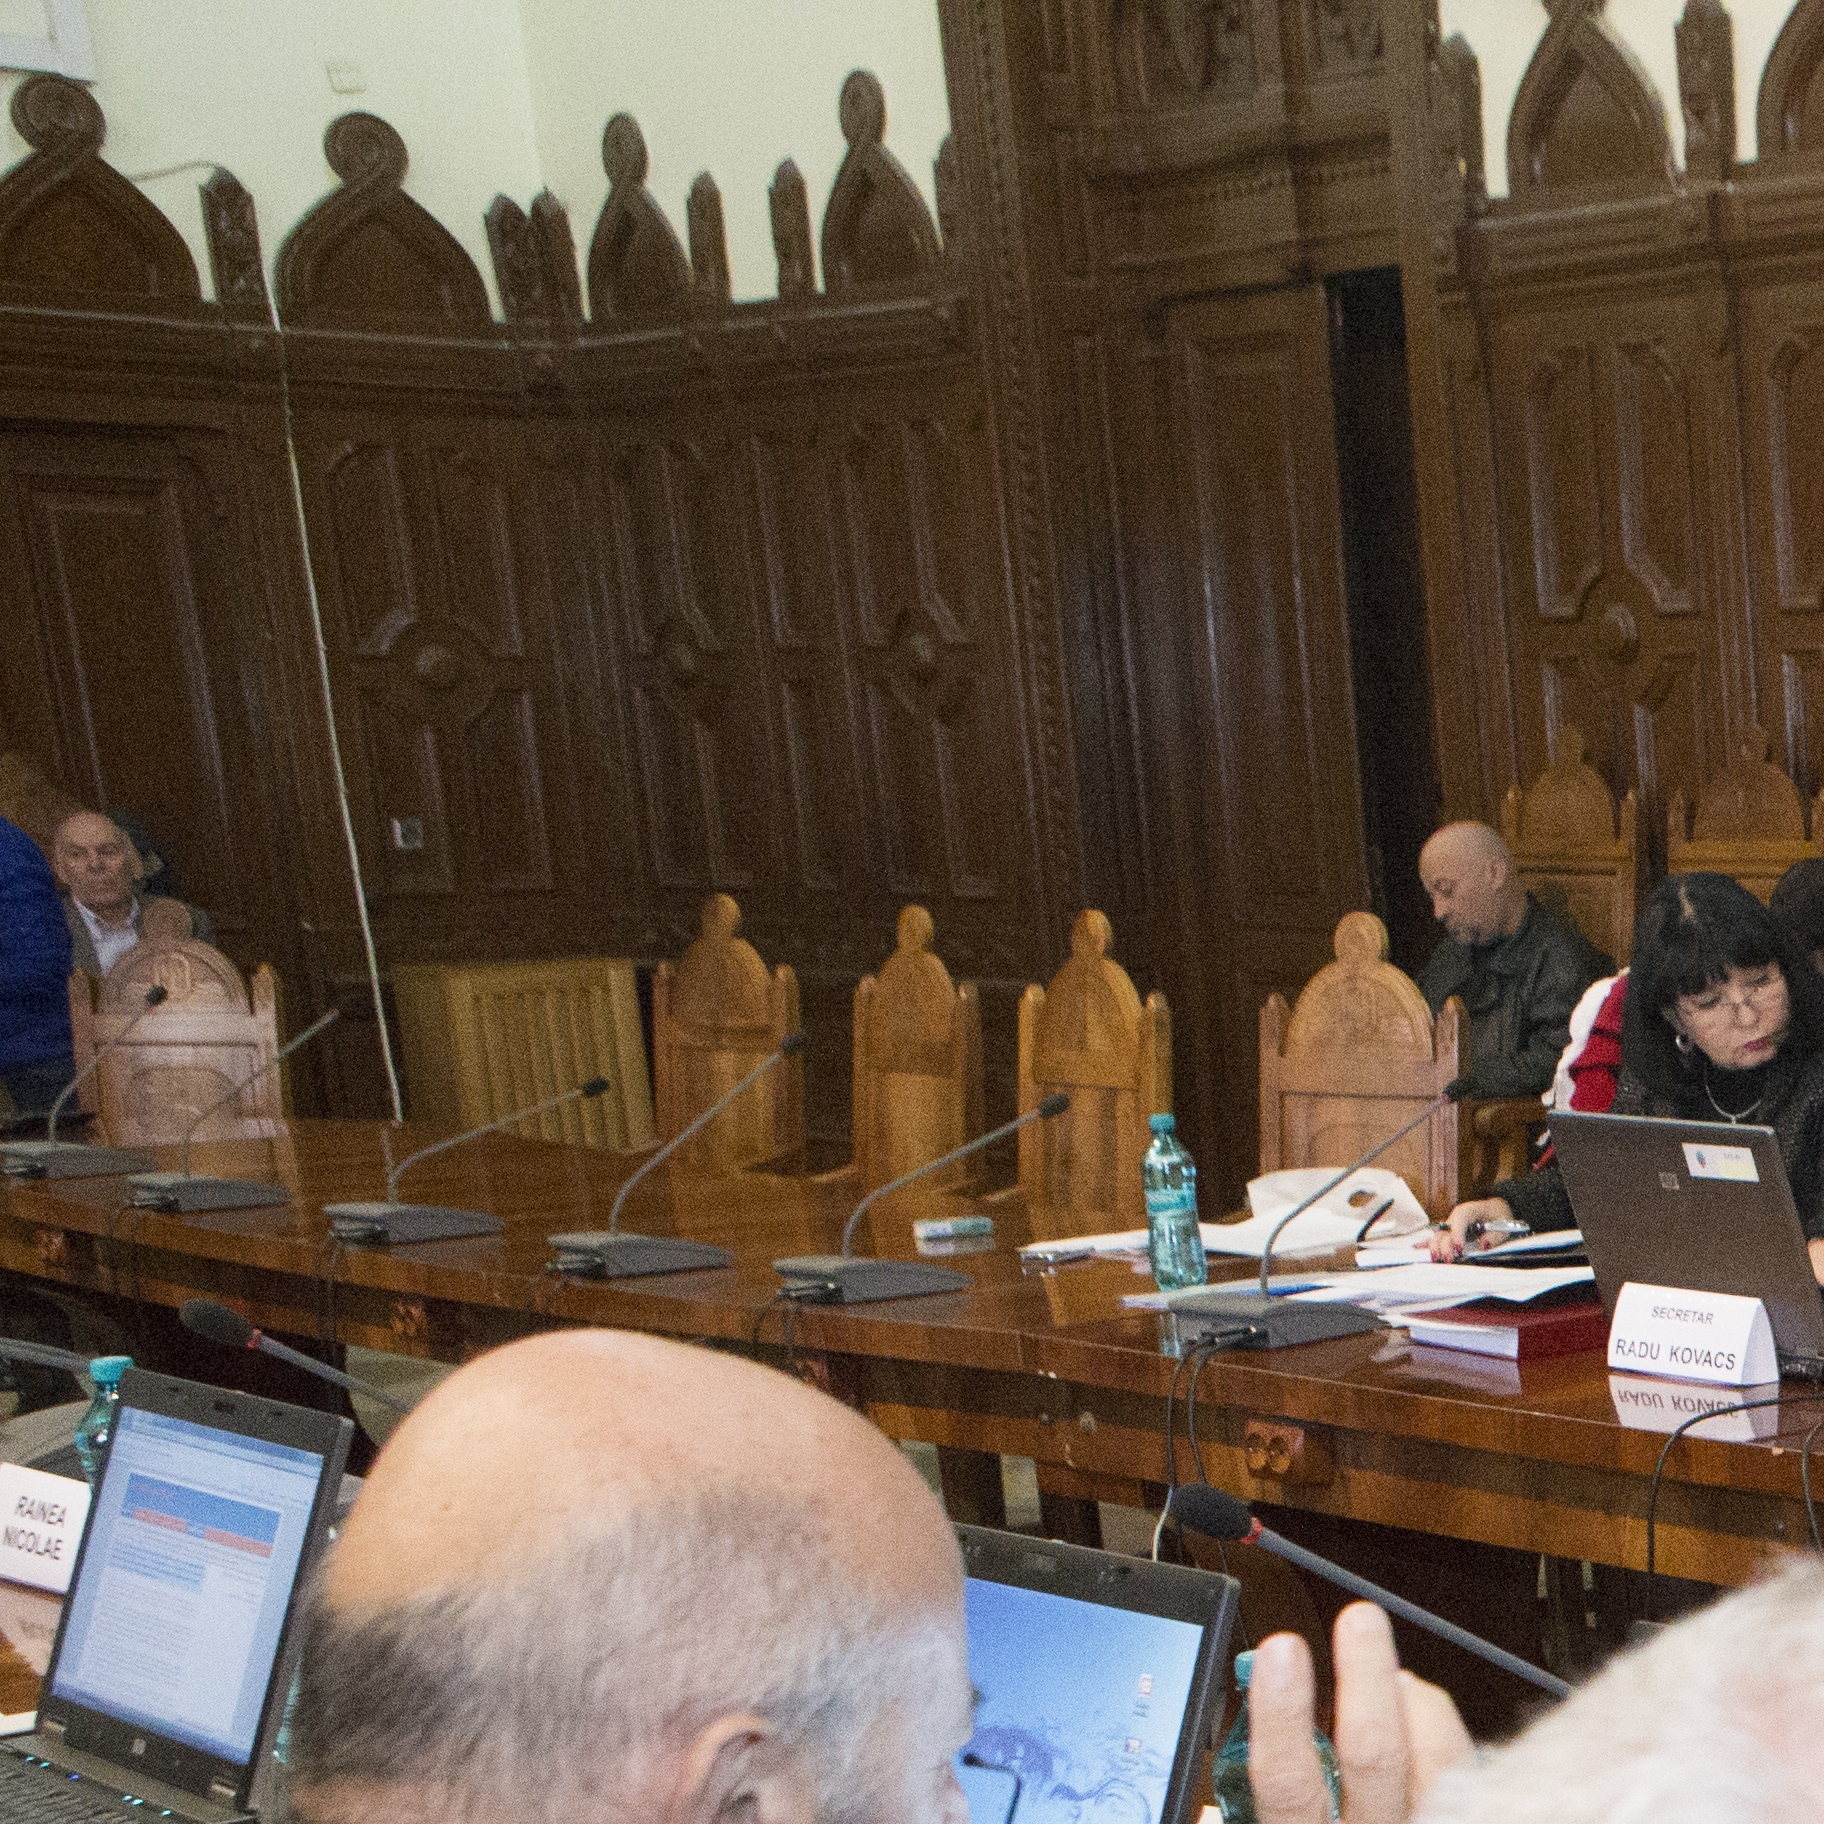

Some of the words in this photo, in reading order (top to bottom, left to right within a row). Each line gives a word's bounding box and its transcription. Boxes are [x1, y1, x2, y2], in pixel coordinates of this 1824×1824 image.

[1651, 1306, 1714, 1325] SECRETAR
[1615, 1338, 1661, 1361] RADU
[1669, 1345, 1736, 1371] KOVACS
[3, 1525, 63, 1561] NICOLAE
